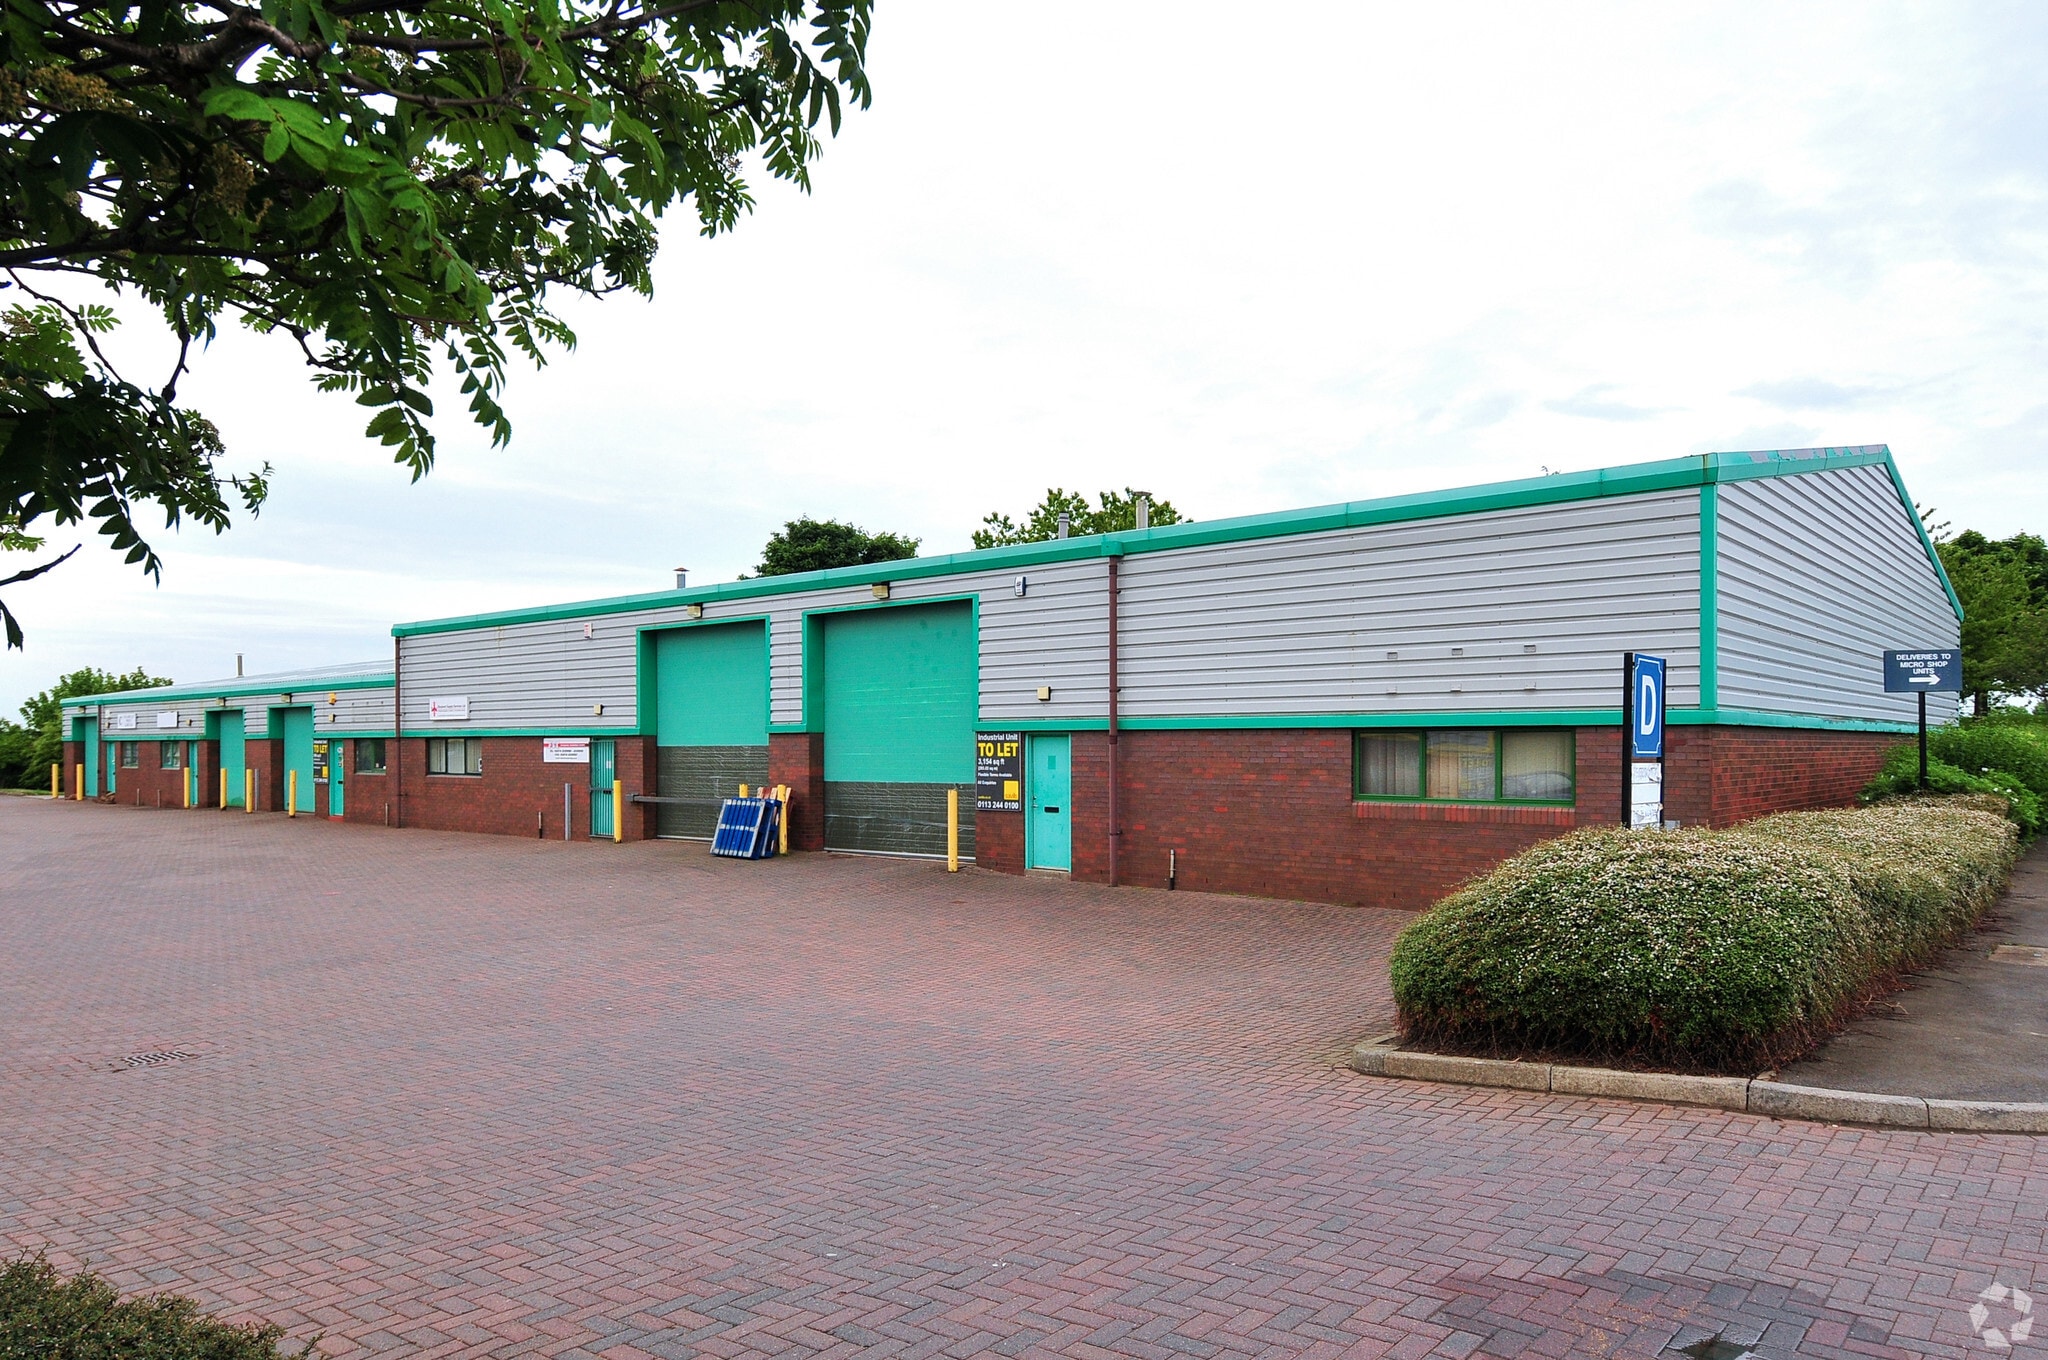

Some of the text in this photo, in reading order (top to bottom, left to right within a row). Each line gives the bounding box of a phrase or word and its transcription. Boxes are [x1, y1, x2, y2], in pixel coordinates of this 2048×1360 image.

[1640, 675, 1656, 735] D
[978, 742, 1018, 756] TO LET
